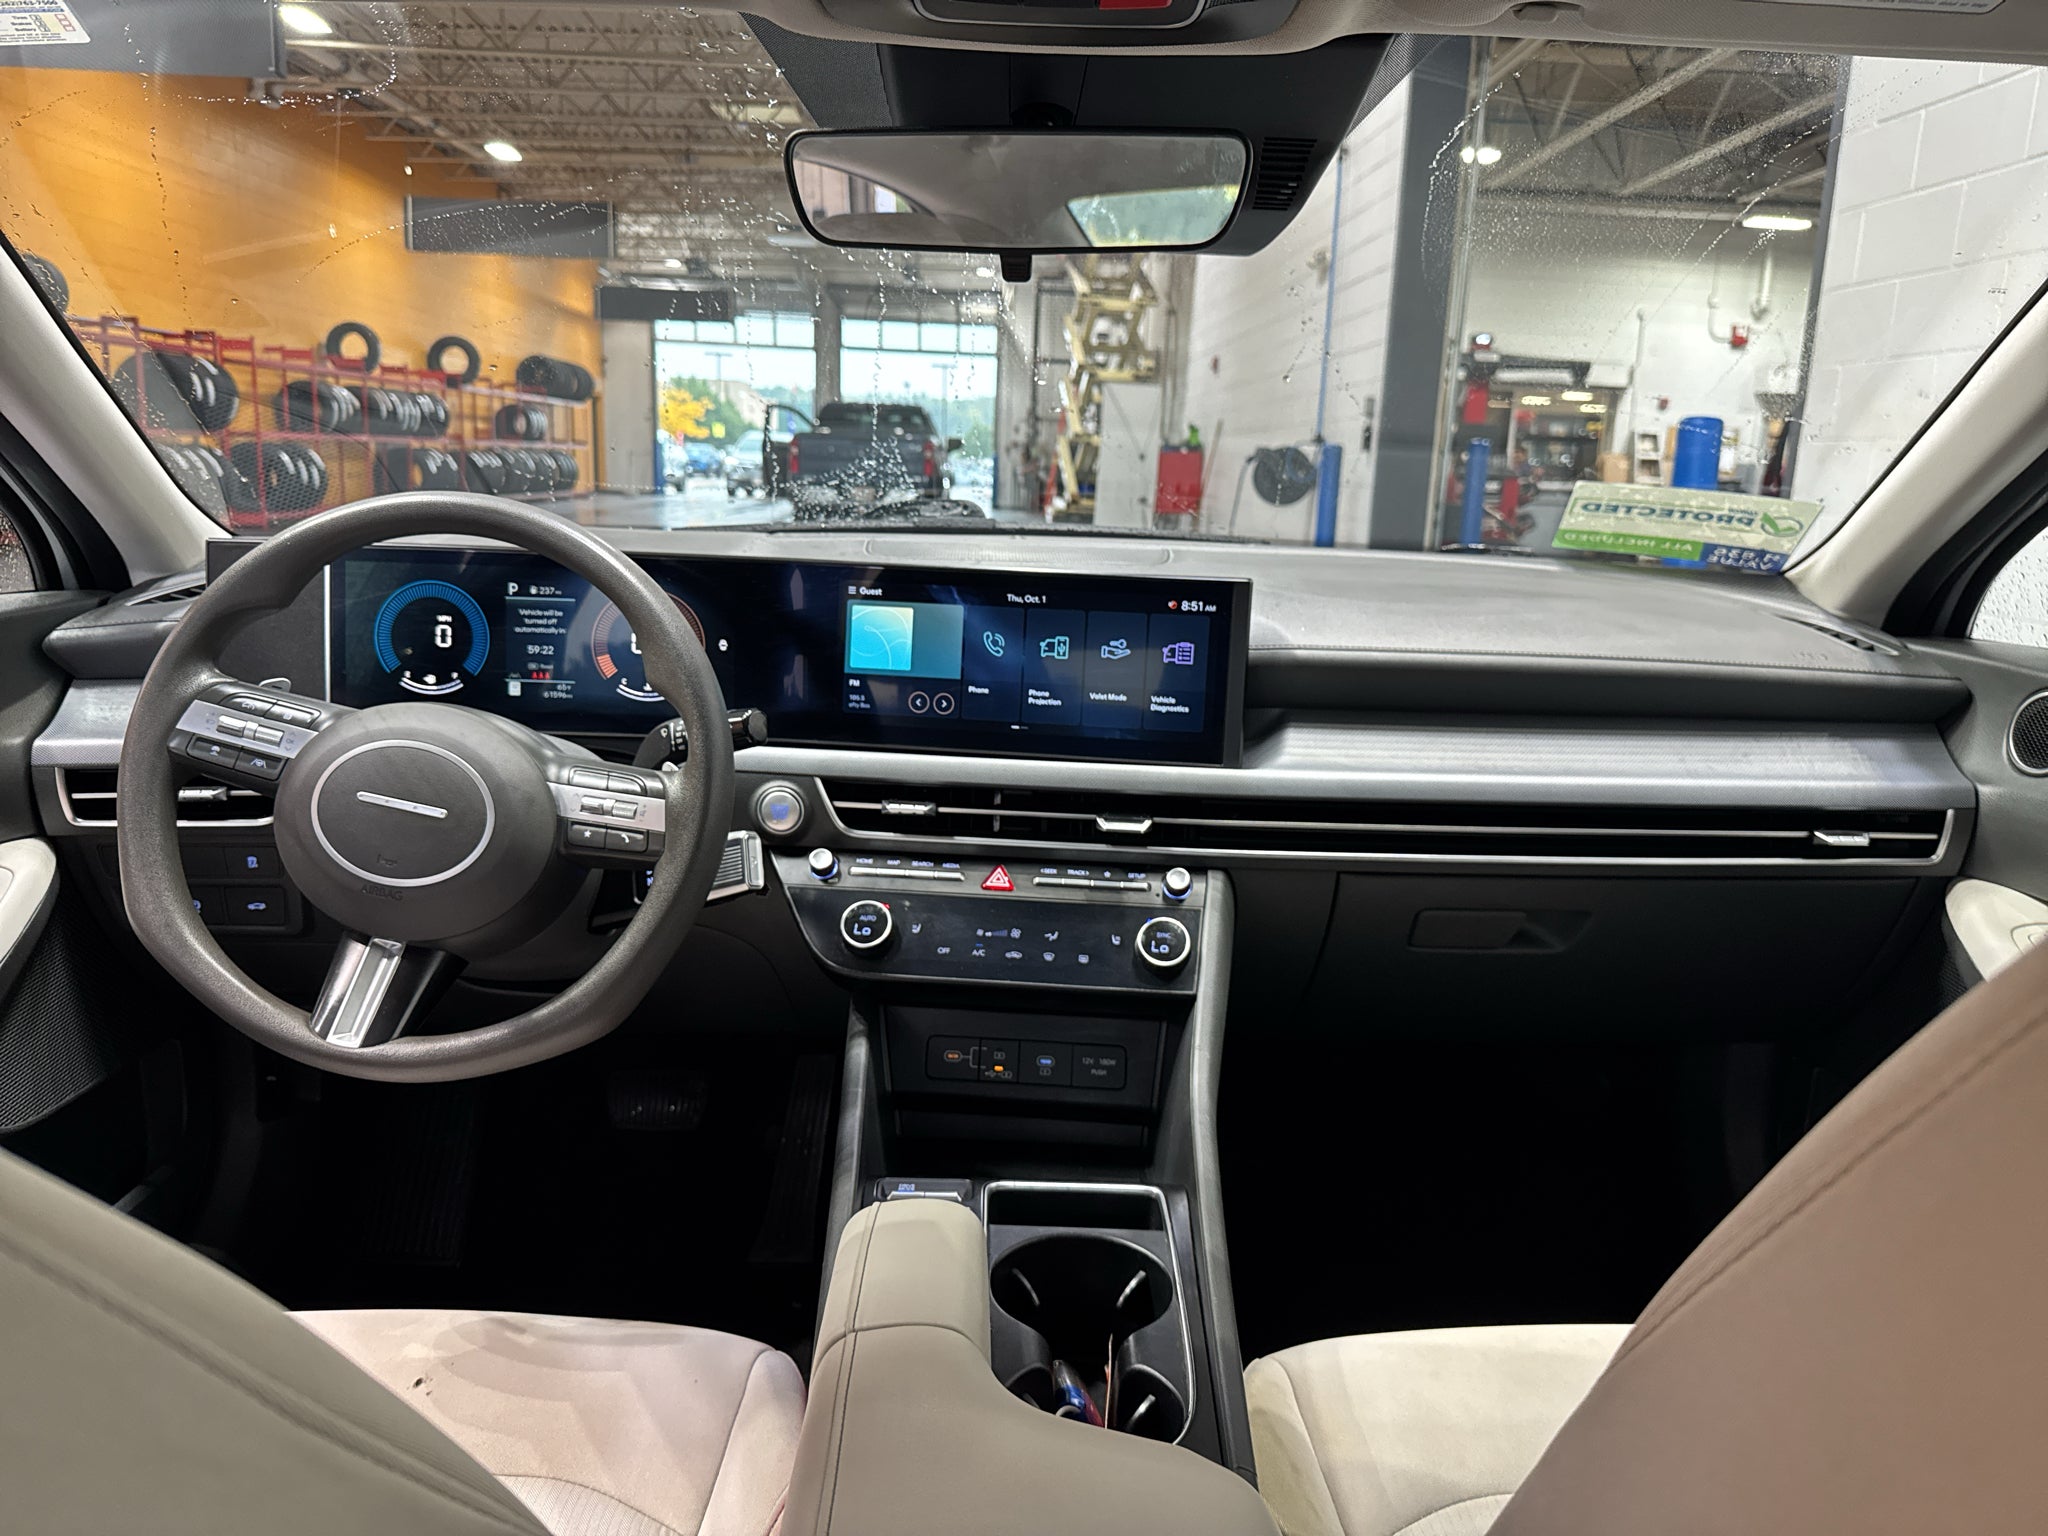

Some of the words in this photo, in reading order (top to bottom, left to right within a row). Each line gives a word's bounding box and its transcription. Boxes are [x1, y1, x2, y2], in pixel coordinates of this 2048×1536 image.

[507, 582, 519, 596] P
[539, 586, 555, 595] 237
[859, 586, 882, 596] Guest
[1006, 593, 1024, 604] Thu,
[1024, 594, 1040, 604] Oct.
[1042, 595, 1047, 604] 1
[1181, 600, 1204, 612] 8:51
[1204, 604, 1217, 612] AM
[517, 608, 543, 617] Vehicle
[543, 609, 555, 617] will
[555, 609, 564, 617] be
[514, 626, 558, 635] automatically
[435, 624, 452, 649] 0
[526, 644, 554, 655] 59:22
[849, 679, 860, 688] FM
[967, 685, 990, 695] Phone
[1028, 689, 1050, 698] Phone
[1028, 697, 1062, 707] Projection
[1089, 692, 1107, 701] Valet
[1108, 692, 1128, 702] Mode
[1150, 695, 1176, 705] Vehicle
[1150, 703, 1190, 714] Diagnostics
[856, 857, 873, 865] HOME
[911, 860, 934, 868] SEARCH
[853, 923, 871, 936] Lo
[937, 946, 951, 954] OFF
[1151, 940, 1169, 954] Lo
[972, 949, 985, 957] A/C
